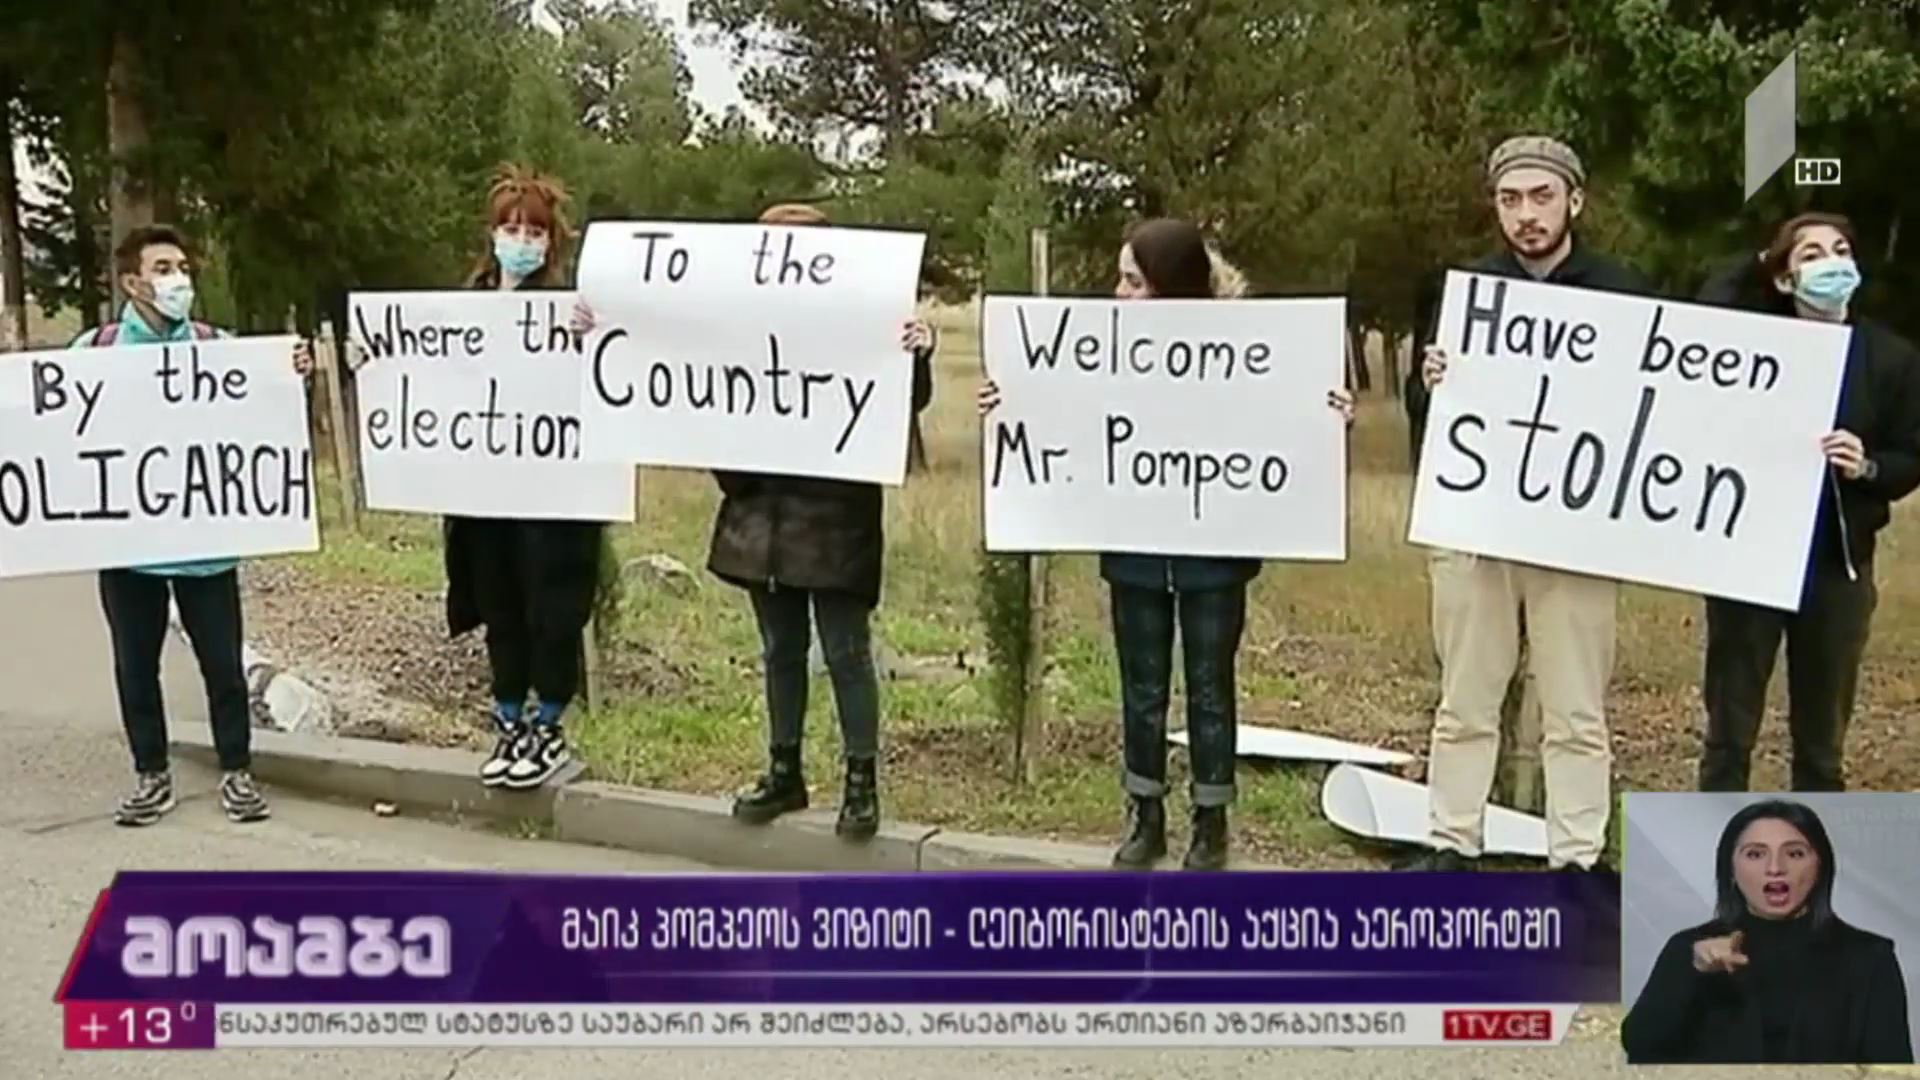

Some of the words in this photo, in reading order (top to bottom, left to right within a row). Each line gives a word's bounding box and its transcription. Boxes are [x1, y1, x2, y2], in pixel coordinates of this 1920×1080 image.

[633, 232, 689, 284] To
[753, 230, 836, 285] the
[354, 303, 484, 360] Where
[1018, 305, 1271, 379] Welcome
[1460, 276, 1597, 363] Have
[1640, 306, 1780, 391] been
[32, 359, 104, 436] By
[155, 345, 247, 403] the
[592, 329, 876, 454] Country
[0, 442, 310, 526] OLIGARCH
[992, 420, 1073, 490] Mr.
[1106, 414, 1288, 520] Pompeo
[1436, 374, 1748, 538] stolen
